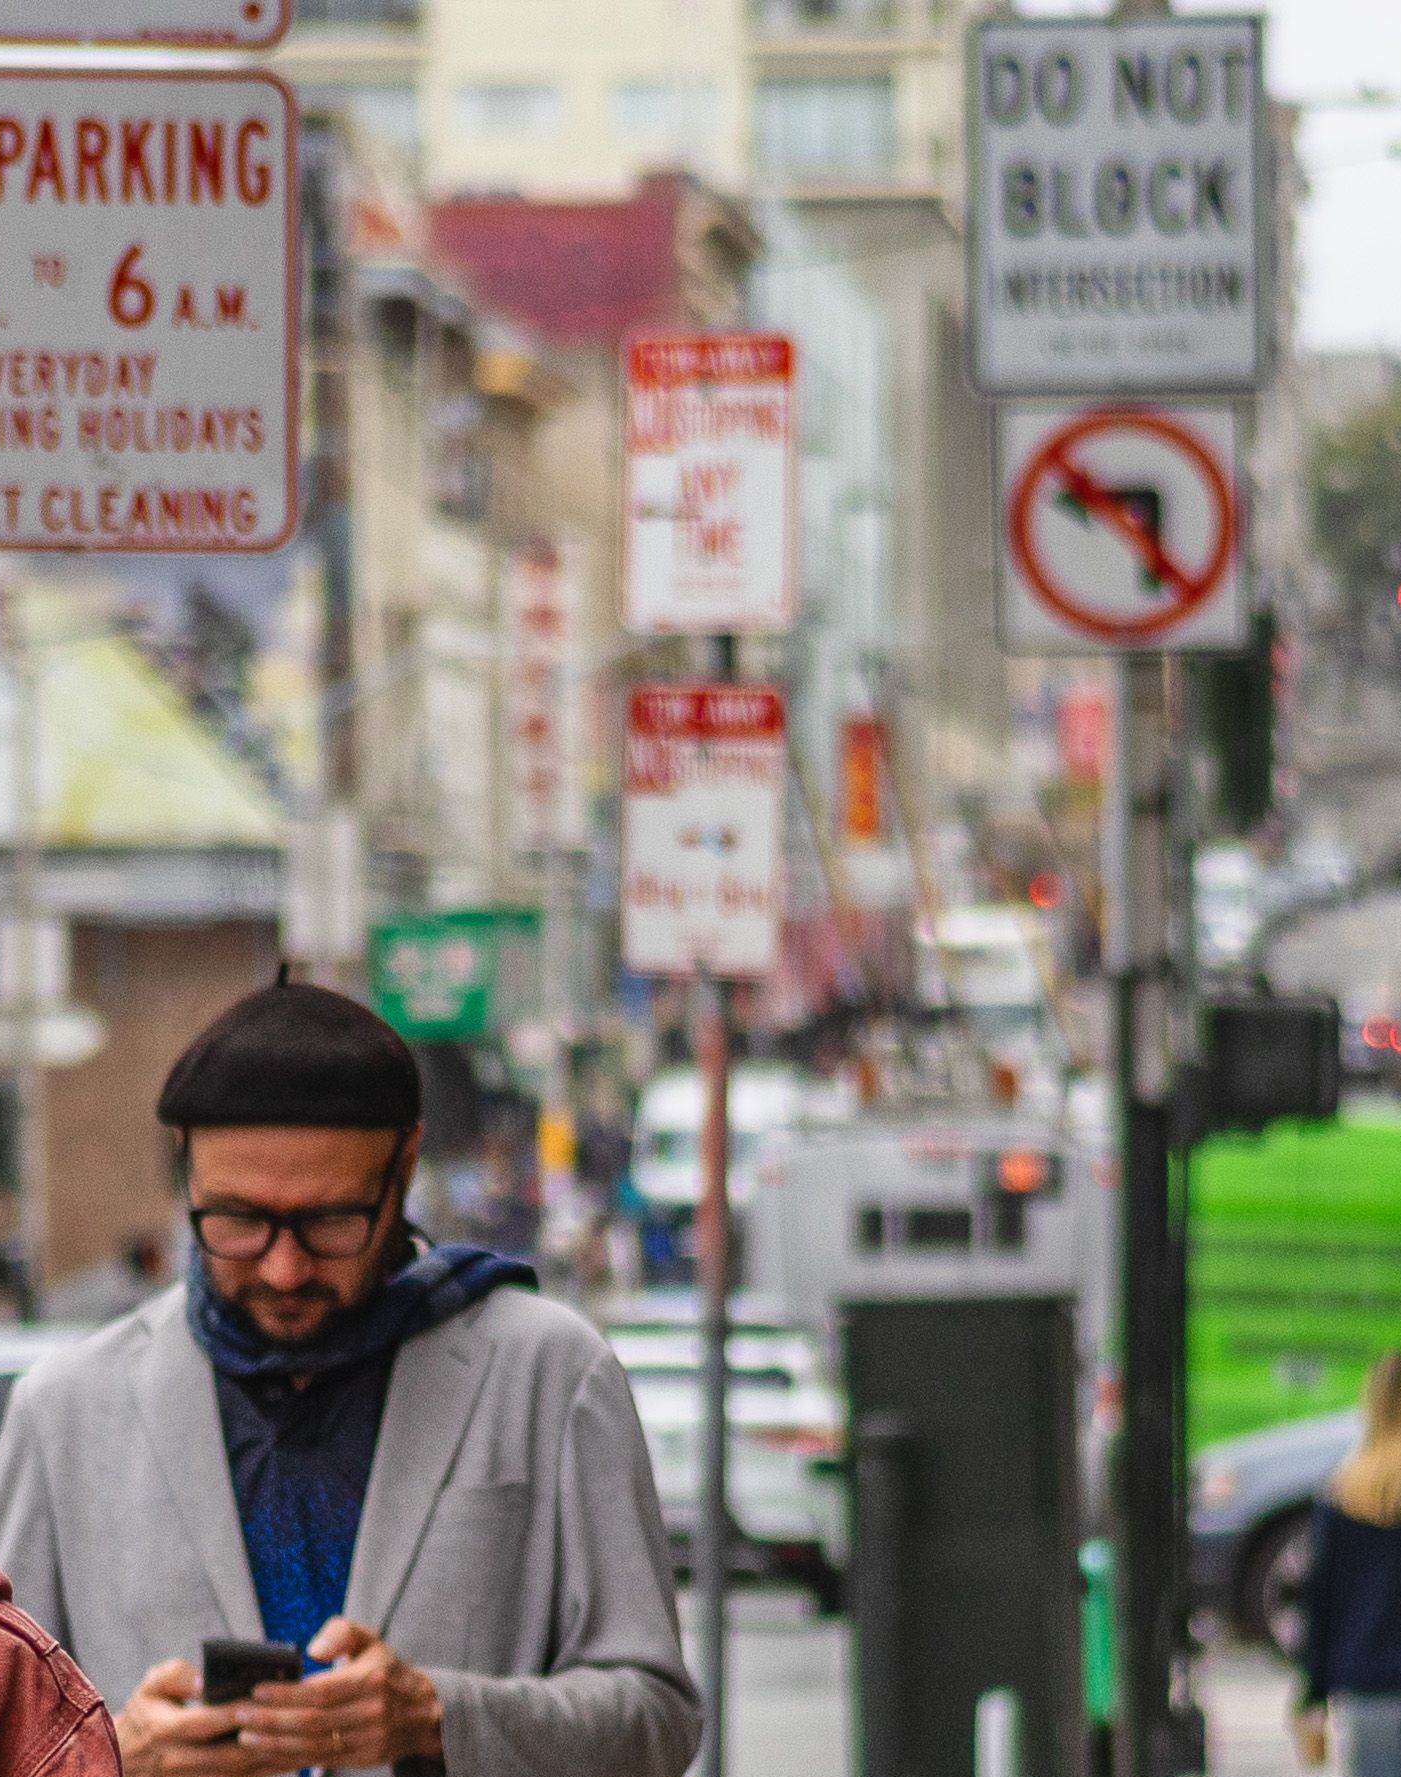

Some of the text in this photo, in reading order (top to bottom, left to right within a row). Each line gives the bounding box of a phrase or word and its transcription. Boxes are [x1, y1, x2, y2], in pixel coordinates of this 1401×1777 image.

[982, 50, 1248, 128] DO NOT
[1002, 155, 1238, 240] BLOCK
[107, 241, 154, 329] 6
[76, 404, 267, 456] HOLIDAYS
[37, 484, 260, 535] CLEANING
